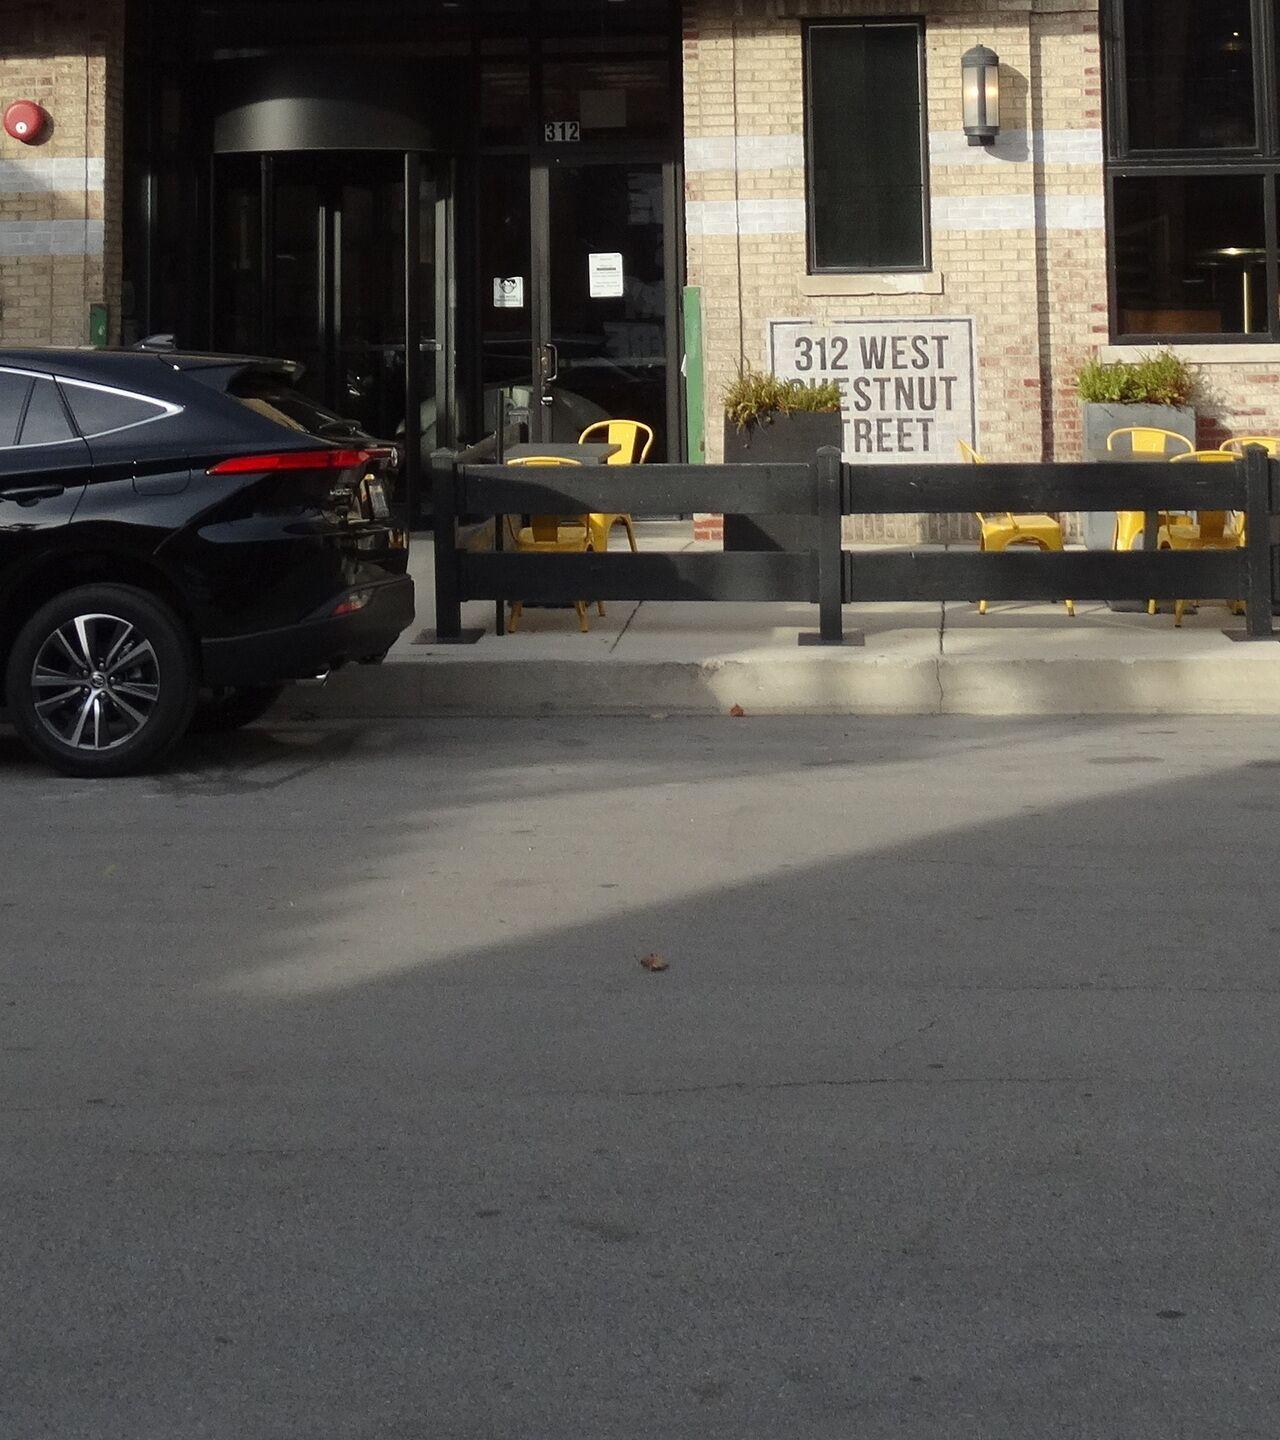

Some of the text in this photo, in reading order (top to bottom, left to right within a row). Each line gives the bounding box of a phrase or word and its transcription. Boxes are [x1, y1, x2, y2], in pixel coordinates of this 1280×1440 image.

[546, 122, 579, 140] 312
[794, 335, 949, 371] 312 WEST
[788, 376, 958, 412] ESTNUT
[842, 418, 934, 453] TREET
